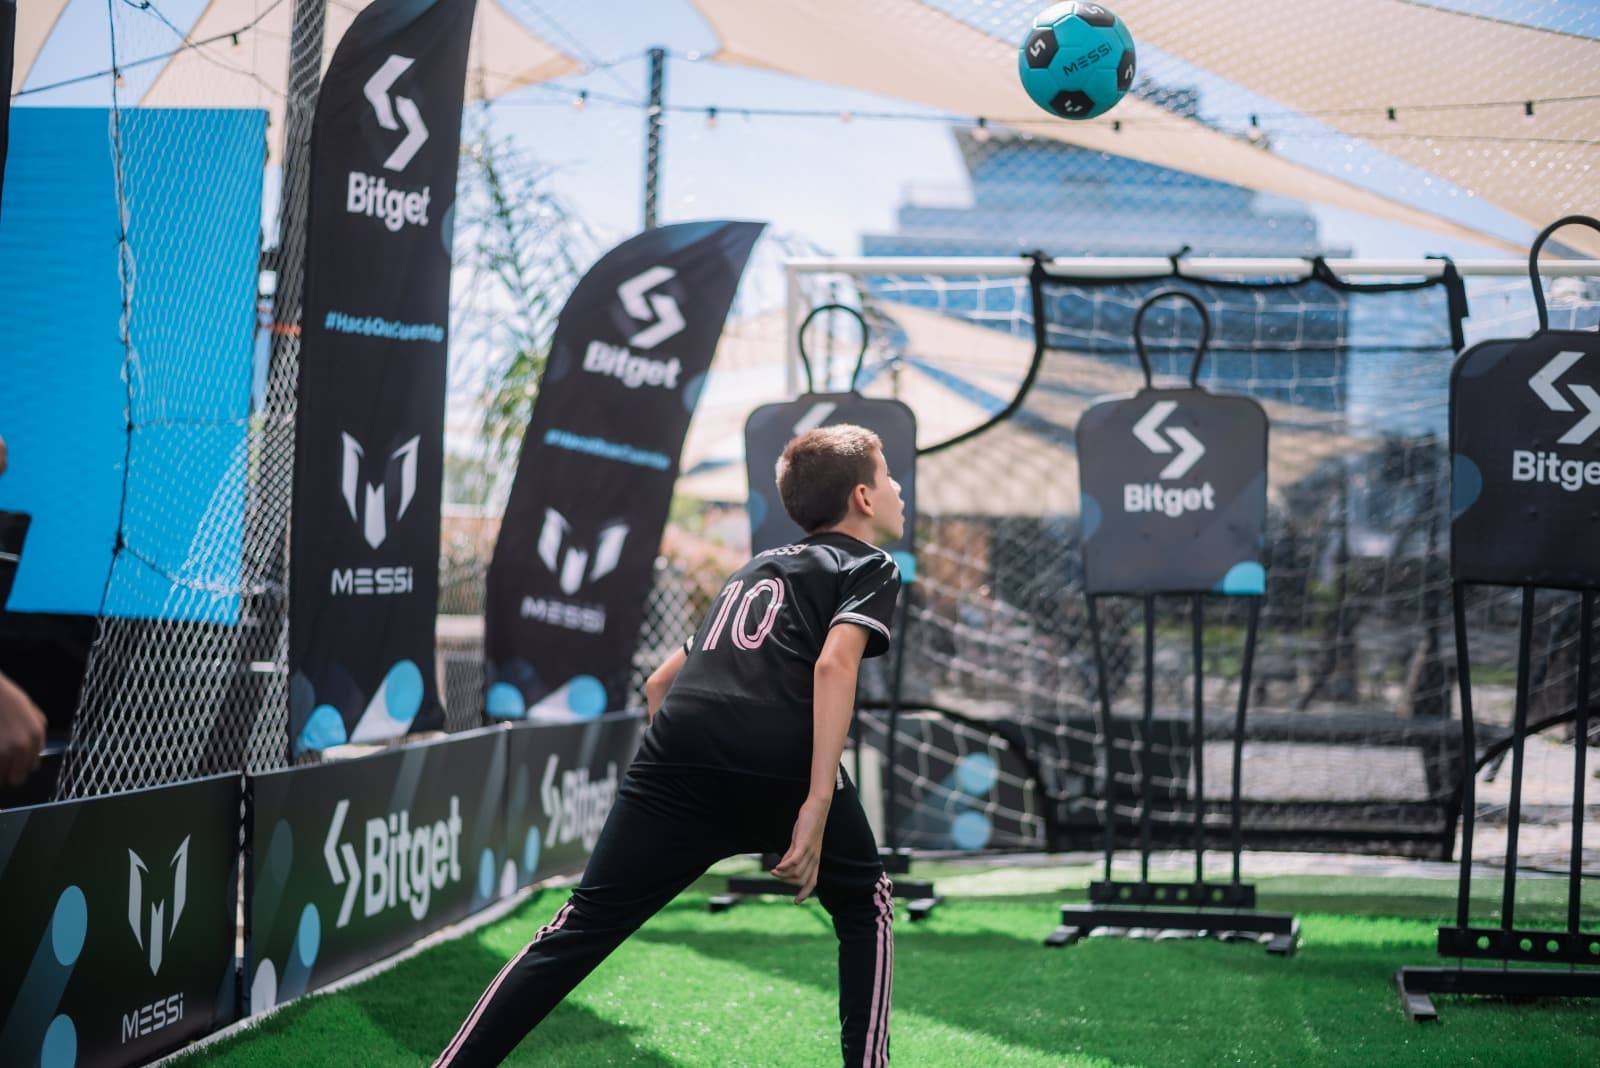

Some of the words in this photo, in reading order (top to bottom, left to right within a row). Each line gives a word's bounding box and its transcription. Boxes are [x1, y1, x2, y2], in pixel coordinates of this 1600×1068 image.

[346, 171, 430, 232] Bitget
[583, 340, 681, 389] Bitget
[1512, 450, 1600, 491] Bitge
[1124, 482, 1215, 517] Bitget
[702, 577, 785, 651] 10
[364, 795, 462, 920] Bitget
